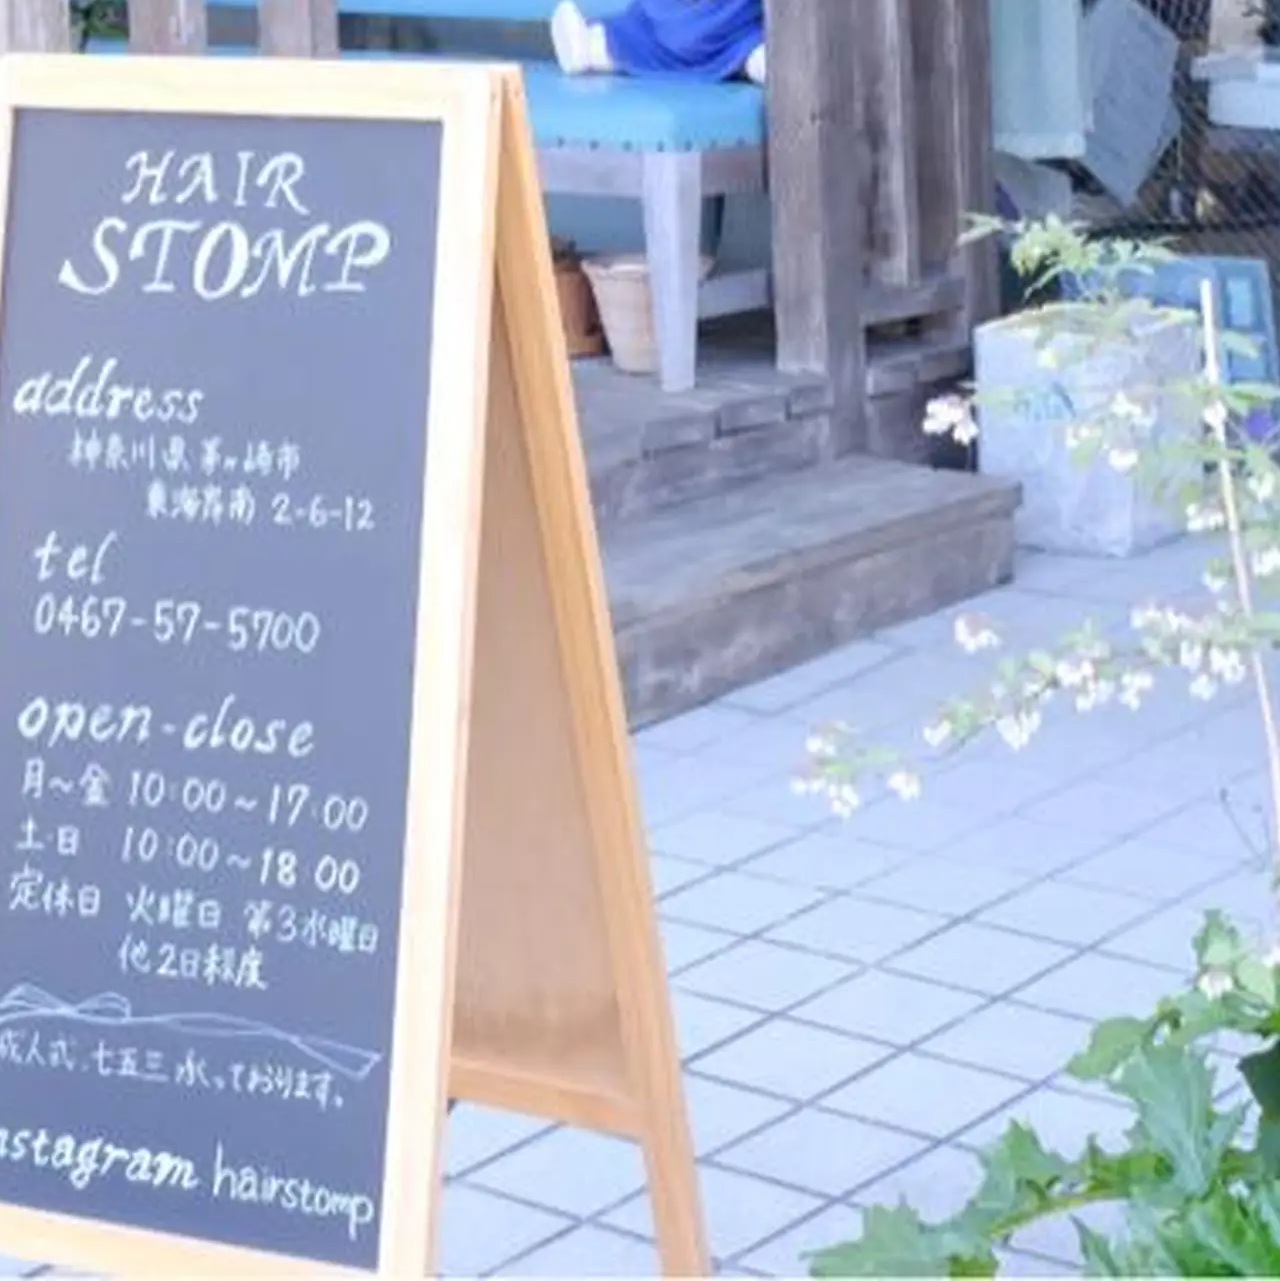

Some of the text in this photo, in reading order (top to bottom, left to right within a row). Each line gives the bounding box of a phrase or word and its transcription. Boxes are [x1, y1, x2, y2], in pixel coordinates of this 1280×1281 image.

[121, 150, 309, 215] HAIR
[58, 216, 390, 300] STOMP
[12, 355, 204, 423] address
[271, 492, 374, 532] 2-6-12
[34, 530, 117, 584] tel
[34, 591, 320, 653] 0467-57-5700
[9, 863, 101, 917] 定休日
[126, 885, 221, 928] 火曜日
[211, 1141, 375, 1240] hairstomp
